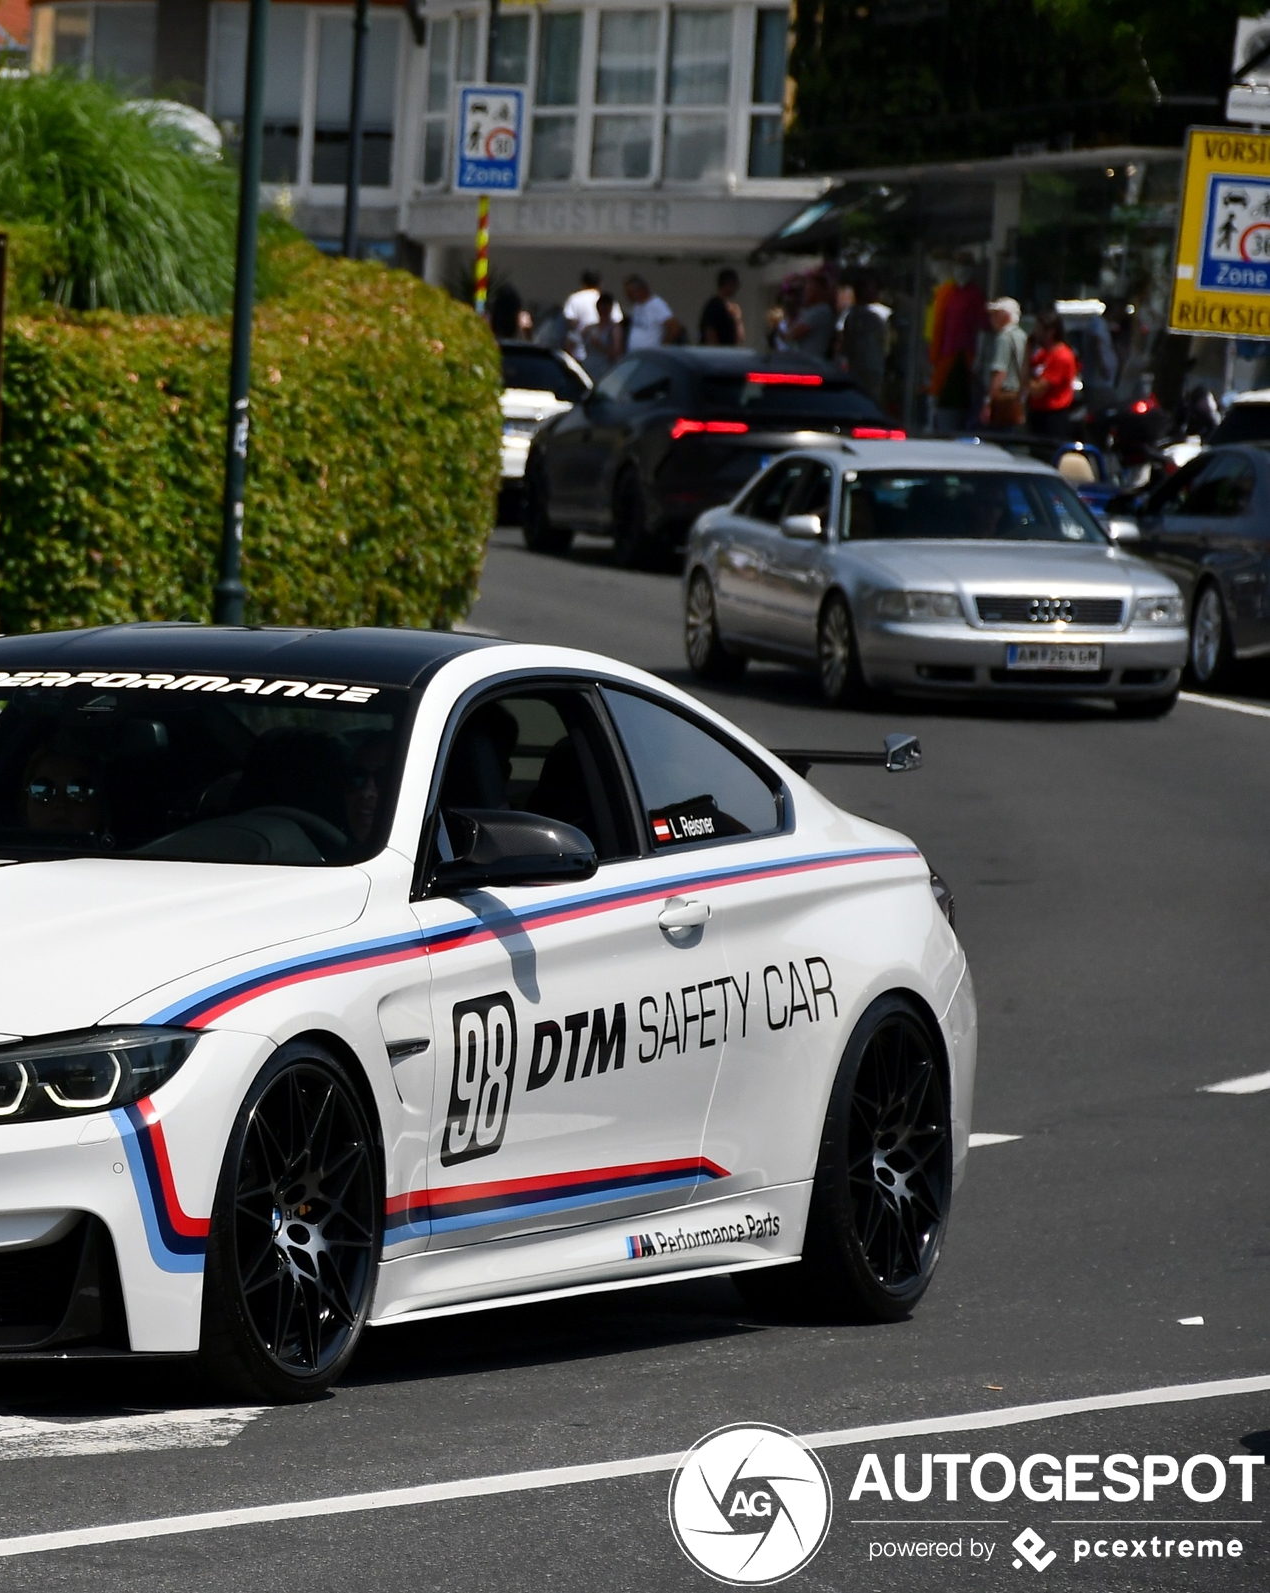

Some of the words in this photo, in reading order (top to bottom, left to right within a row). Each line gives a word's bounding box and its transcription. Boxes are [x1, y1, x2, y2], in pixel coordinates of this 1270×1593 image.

[1205, 139, 1270, 165] VORSI
[463, 164, 514, 187] Zone
[516, 201, 670, 231] ENGSTLER
[1217, 263, 1268, 287] Zone
[679, 815, 715, 837] Reisner
[449, 1004, 512, 1154] 98
[525, 1002, 626, 1092] DTM
[638, 971, 750, 1064] SAFETY
[763, 956, 838, 1031] CAR
[654, 1223, 745, 1255] Performance
[745, 1212, 780, 1240] Parts
